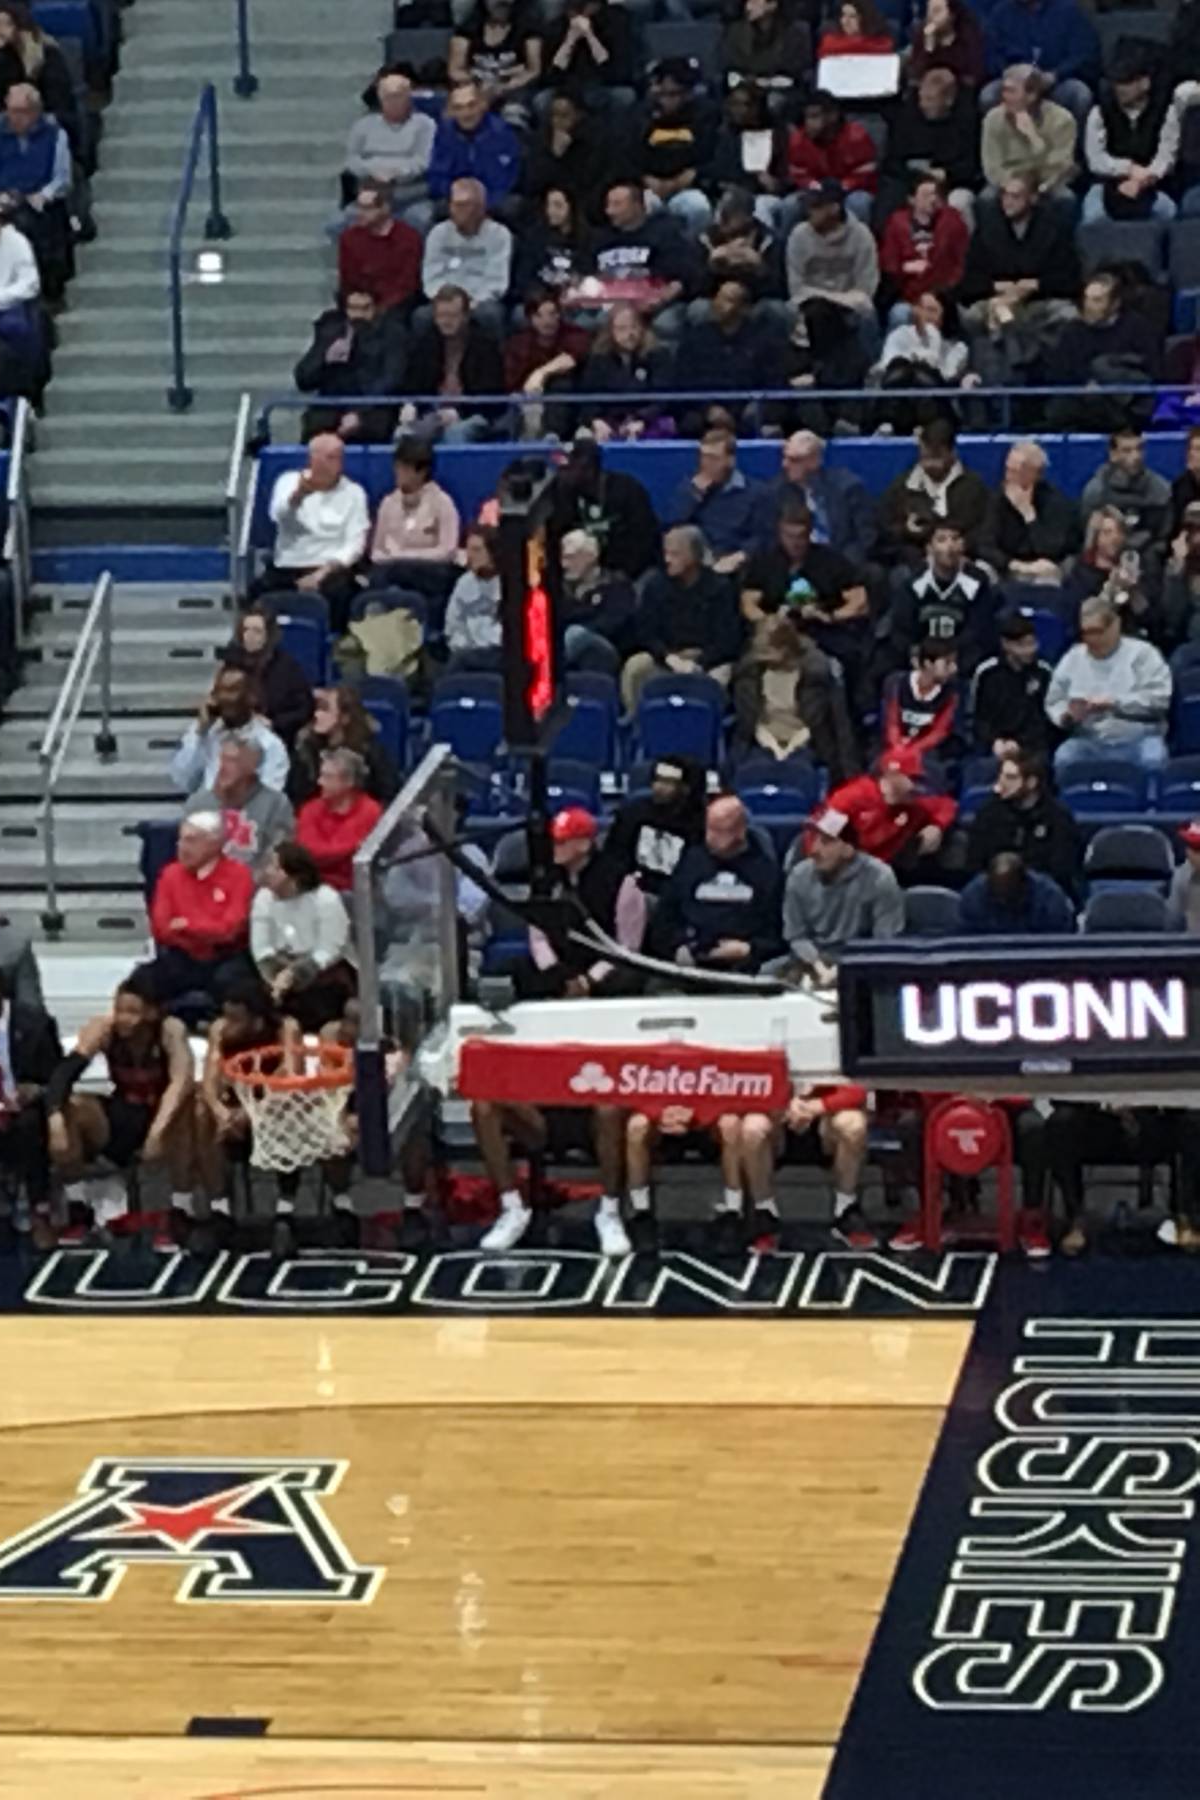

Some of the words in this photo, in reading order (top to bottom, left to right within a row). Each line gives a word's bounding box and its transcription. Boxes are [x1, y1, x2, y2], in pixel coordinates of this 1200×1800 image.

[901, 979, 1186, 1044] UCONN
[24, 1249, 998, 1310] UCONN
[912, 1319, 1200, 1711] HUSKIES
